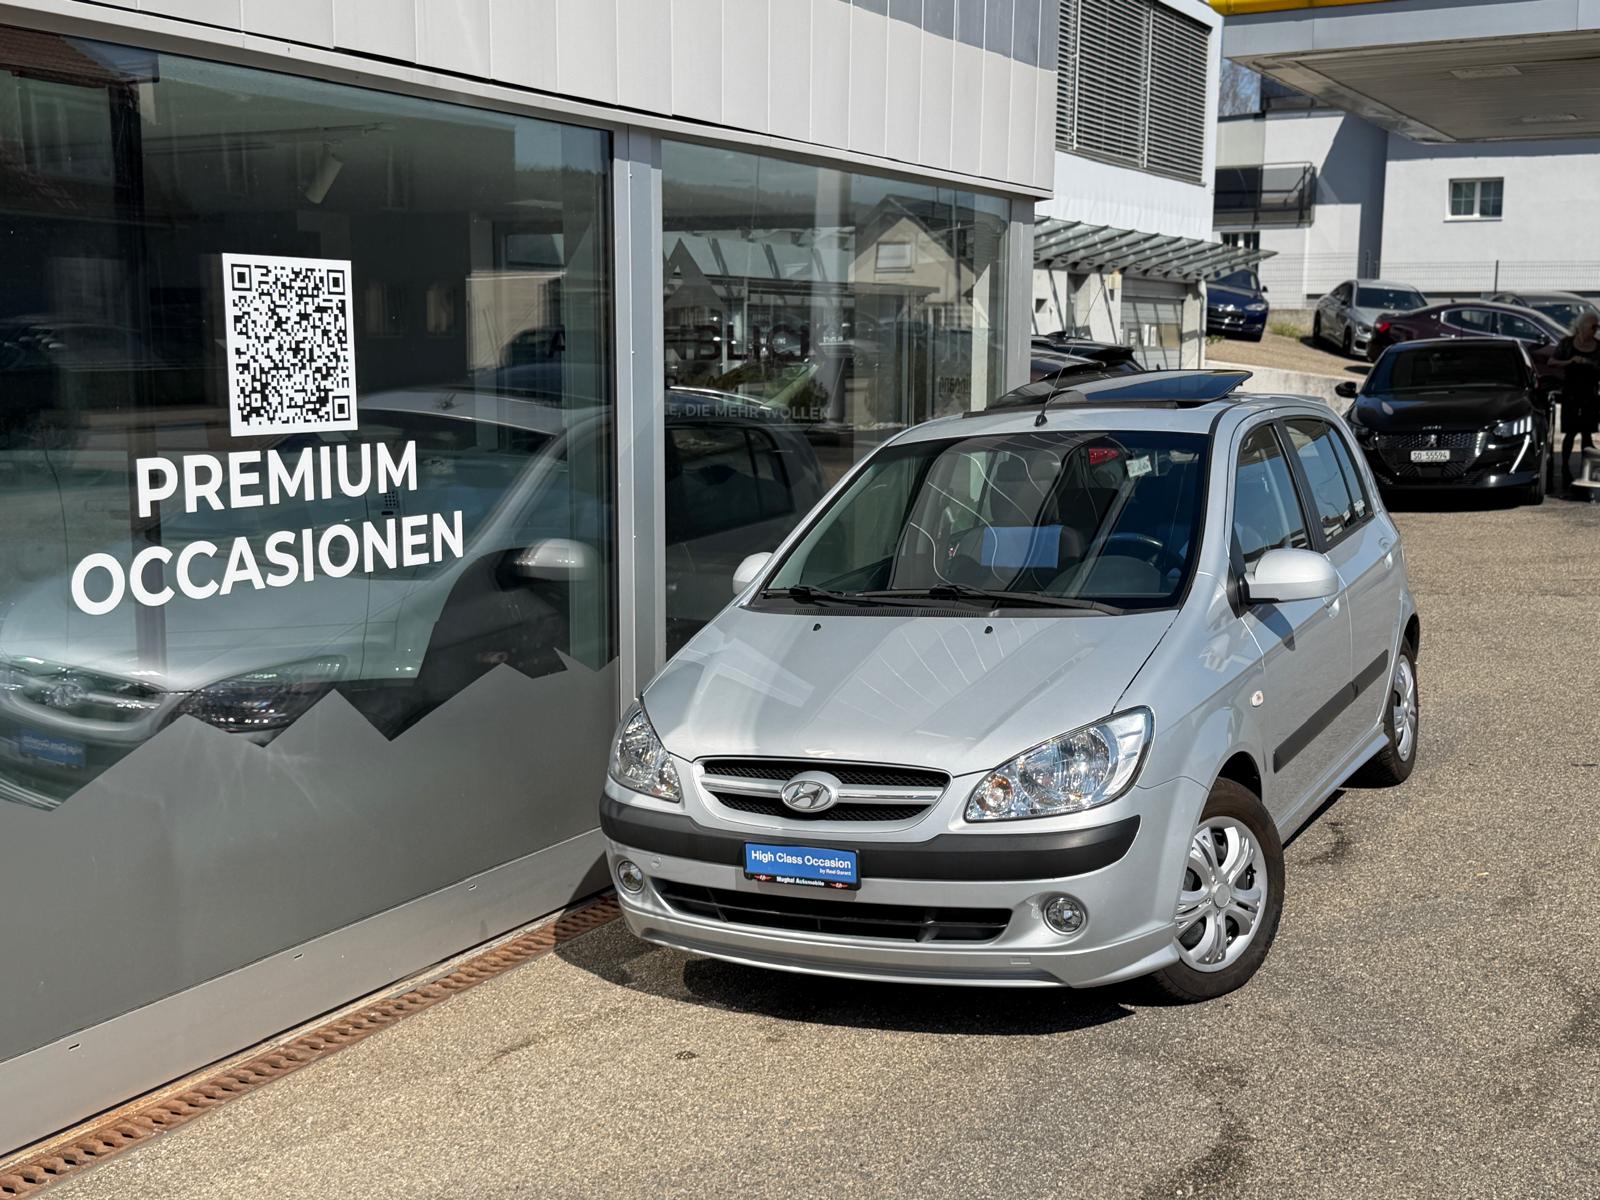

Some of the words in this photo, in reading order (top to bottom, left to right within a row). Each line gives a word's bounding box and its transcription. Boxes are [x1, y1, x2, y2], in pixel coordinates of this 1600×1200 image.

[685, 404, 711, 417] DIE
[715, 404, 759, 418] MEHR
[764, 406, 832, 420] WOLLEN
[136, 440, 418, 518] PREMIUM
[71, 510, 464, 616] OCCASIONEN
[751, 850, 774, 863] High
[776, 852, 803, 864] Class
[804, 855, 851, 869] Occasion
